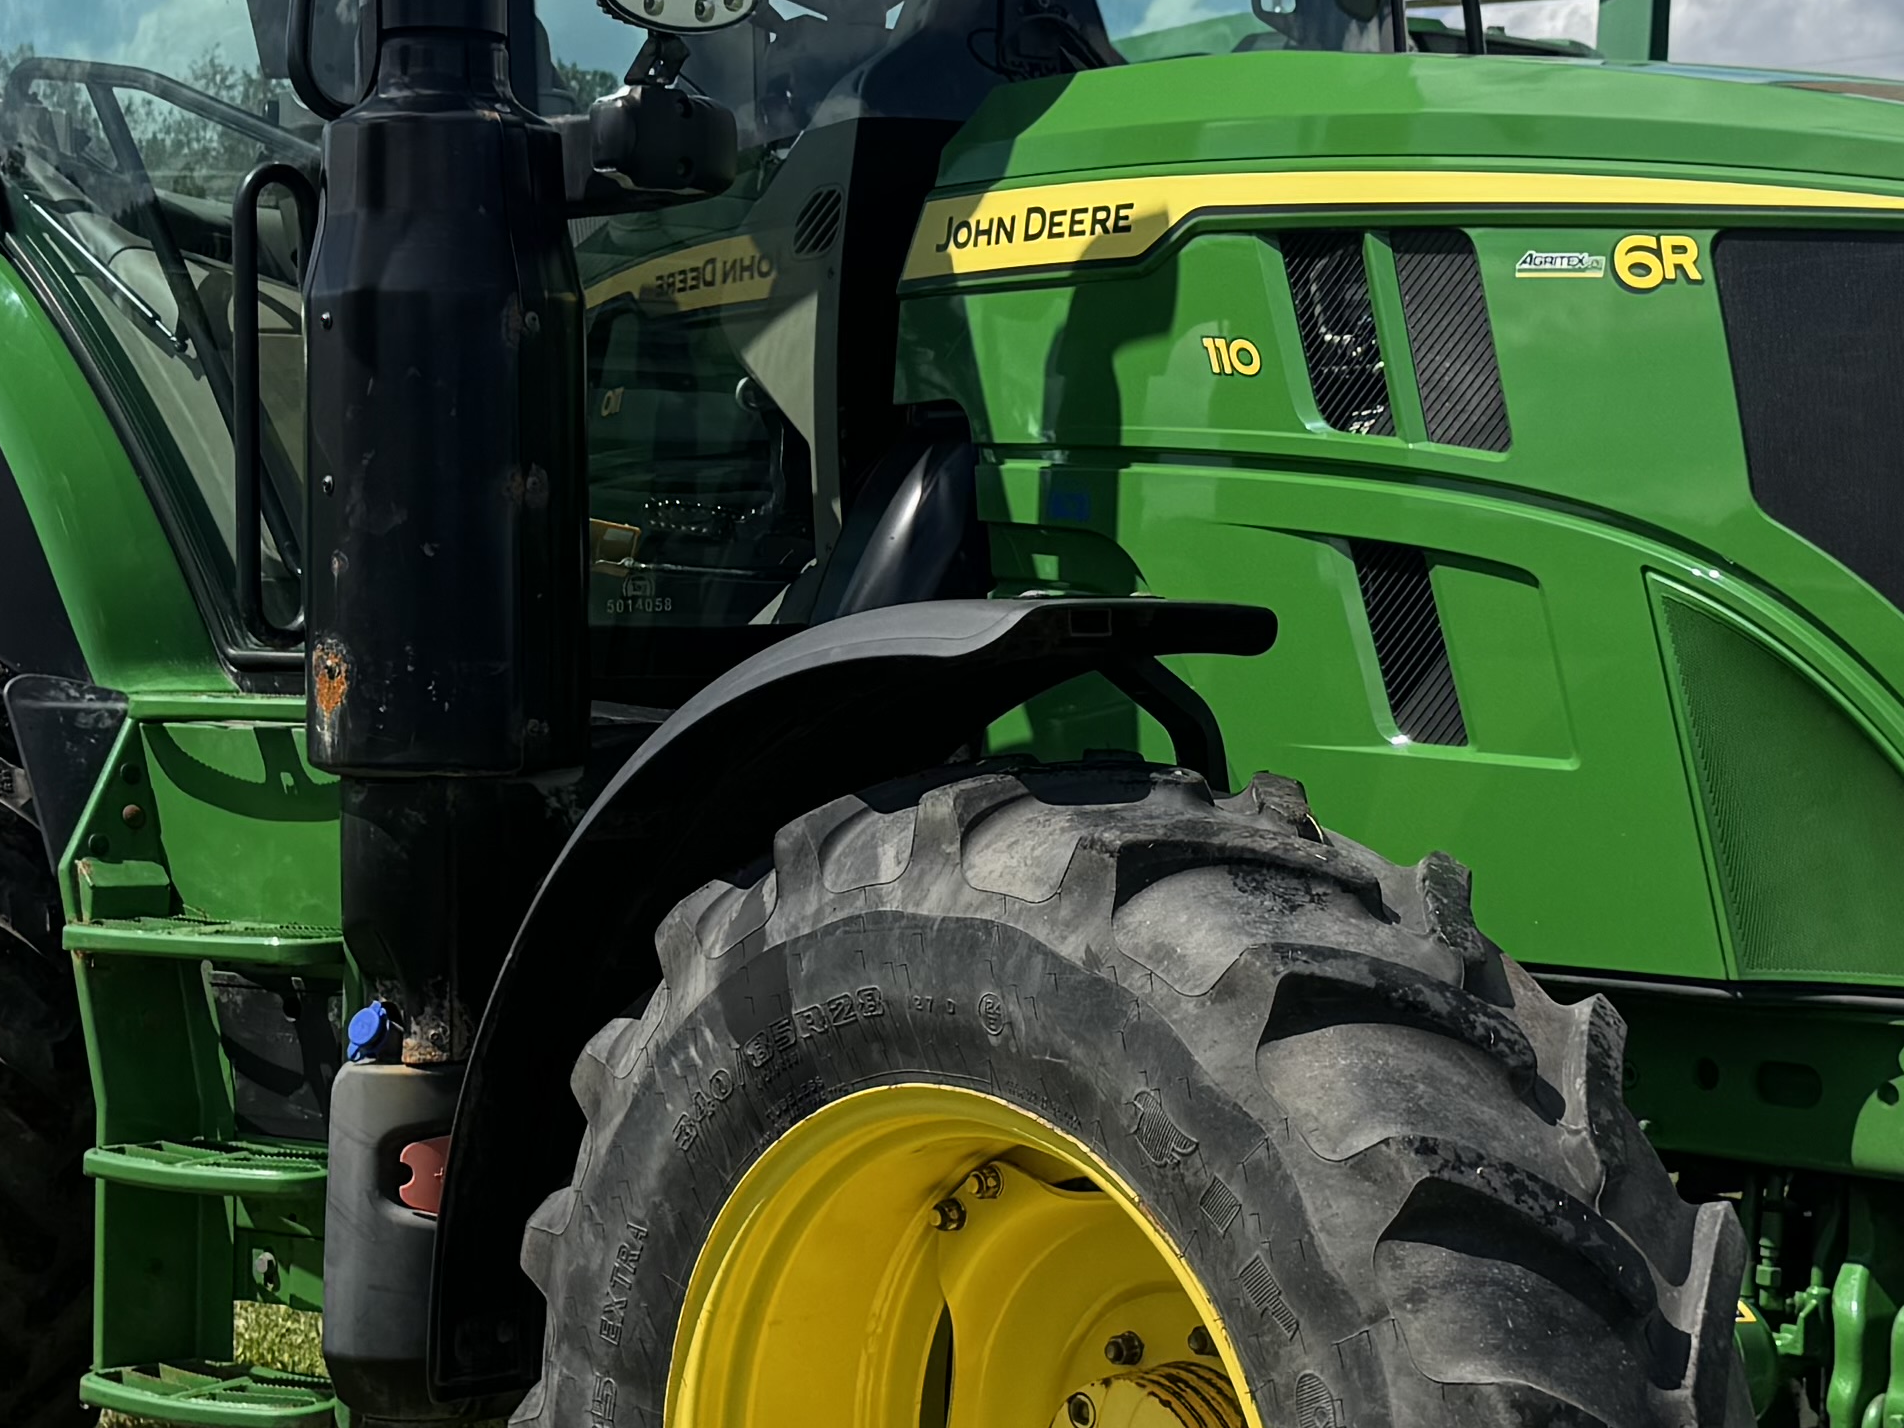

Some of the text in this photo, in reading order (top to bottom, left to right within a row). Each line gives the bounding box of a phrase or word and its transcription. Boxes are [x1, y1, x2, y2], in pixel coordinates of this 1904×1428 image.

[935, 202, 1135, 253] JOHN DEERE
[1613, 233, 1703, 290] 6R
[1201, 336, 1262, 377] 110
[606, 597, 673, 614] 5014058
[671, 985, 884, 1152] 340/85R28
[599, 1220, 649, 1347] EXTRA
